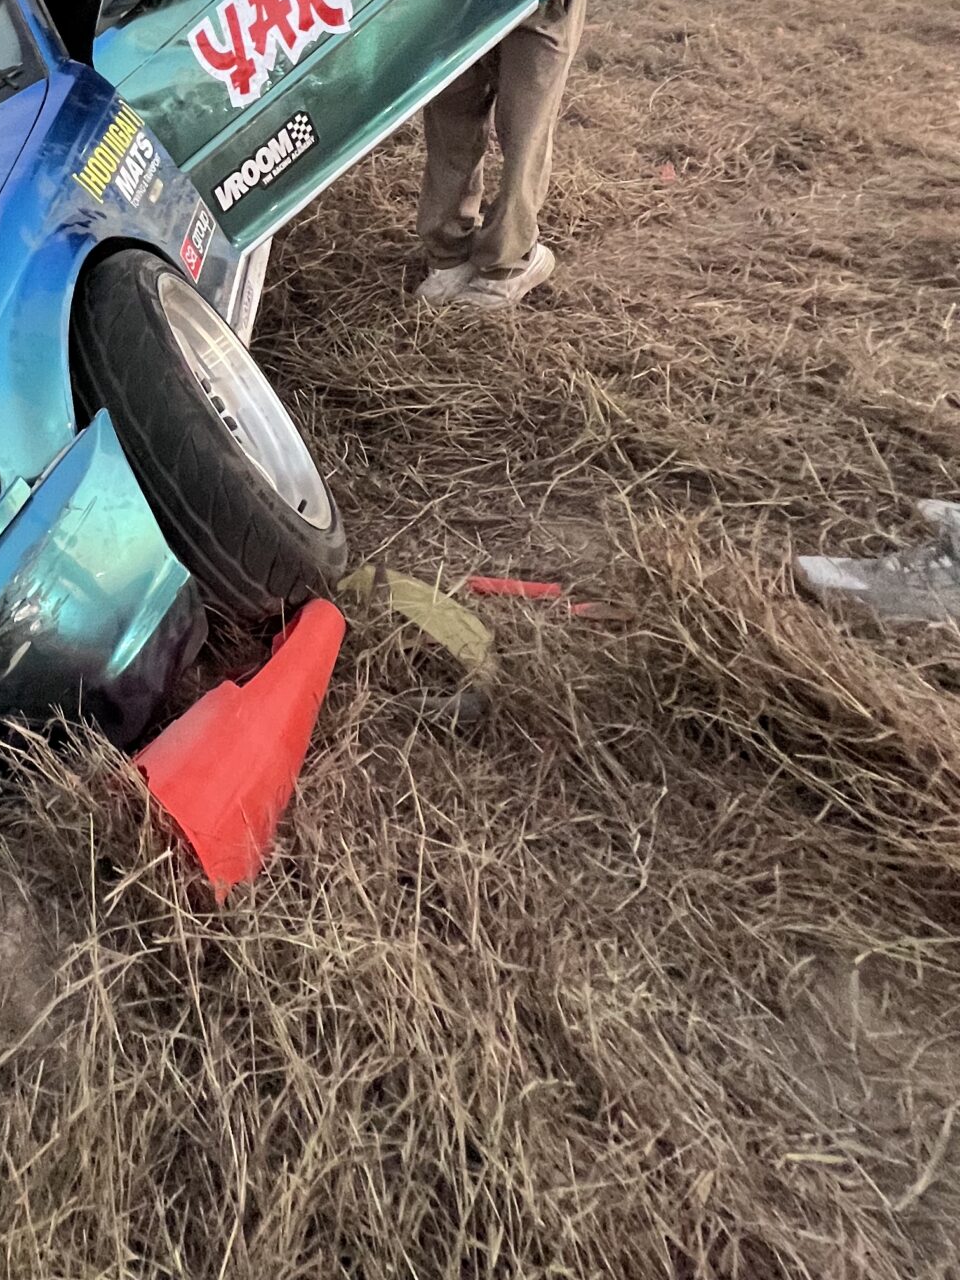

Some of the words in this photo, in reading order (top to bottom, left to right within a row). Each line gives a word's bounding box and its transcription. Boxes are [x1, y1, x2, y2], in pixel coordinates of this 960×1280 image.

[115, 131, 154, 201] MATS
[214, 128, 294, 212] VROOM
[192, 210, 211, 253] group
